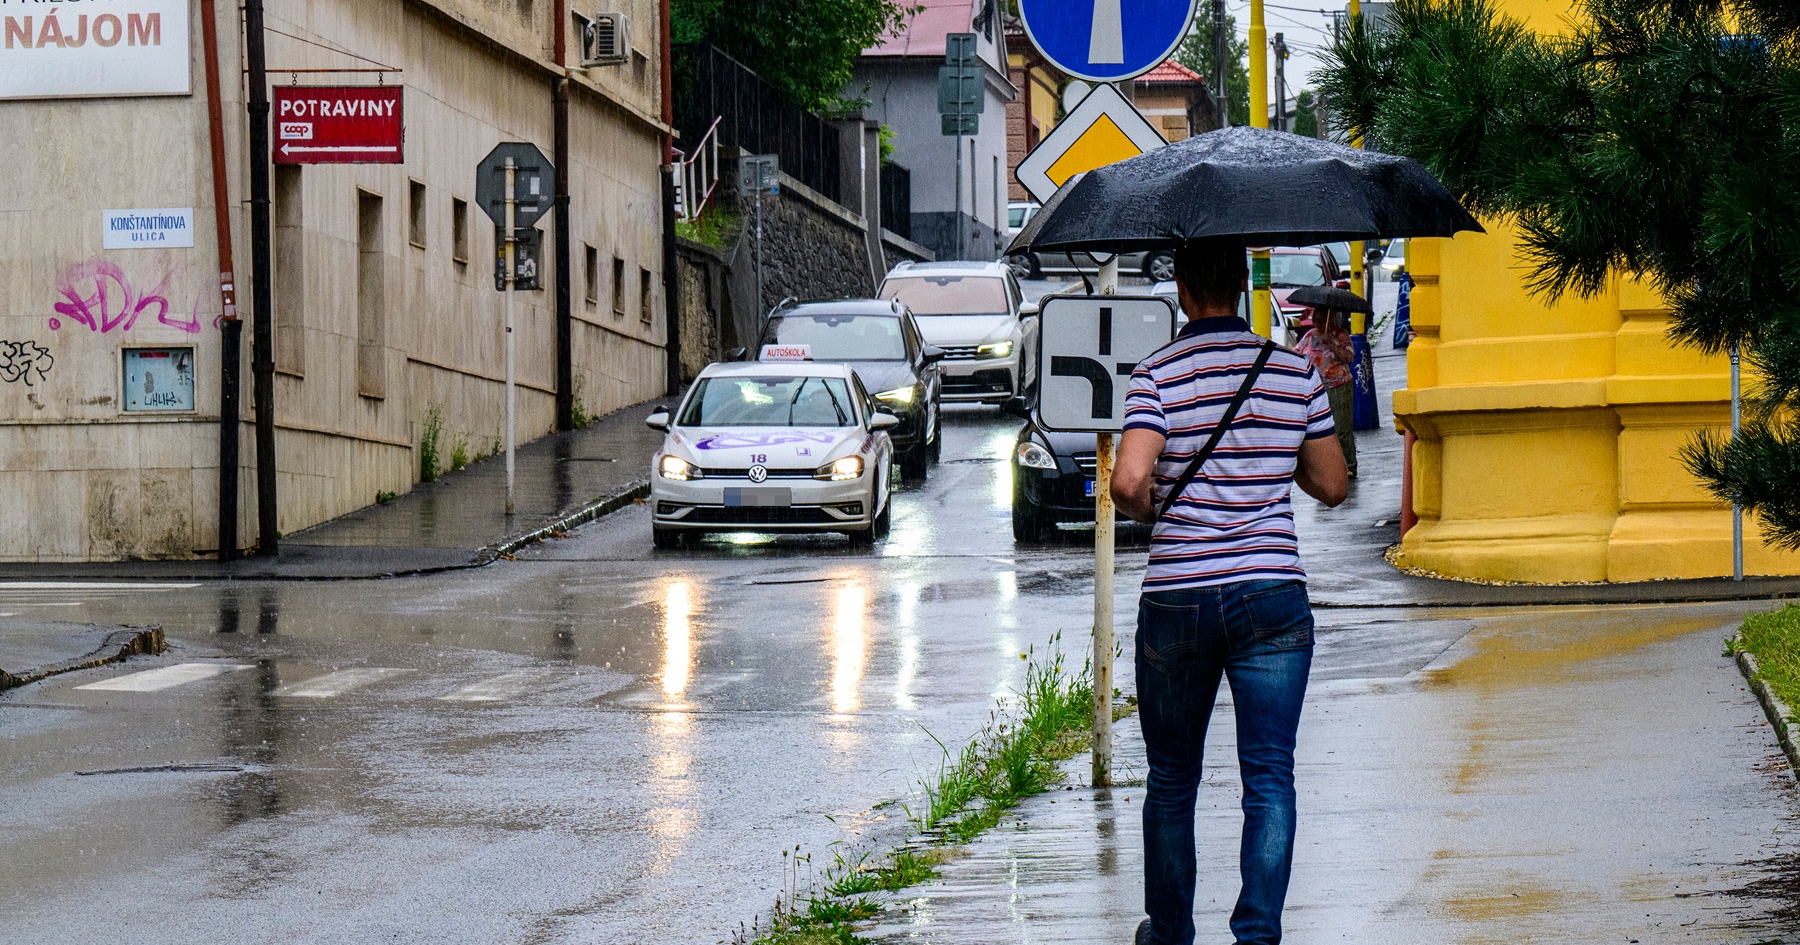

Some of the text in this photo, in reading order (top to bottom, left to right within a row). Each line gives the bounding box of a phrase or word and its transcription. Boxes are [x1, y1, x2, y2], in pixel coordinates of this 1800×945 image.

[4, 7, 161, 49] NÁJOM
[280, 99, 396, 117] POTRAVINY
[284, 125, 309, 137] coop
[110, 213, 186, 231] KONŠTANTÍNOVA
[131, 232, 166, 242] ULICA
[766, 347, 806, 357] AUTOŠKOLA
[750, 454, 767, 464] 18
